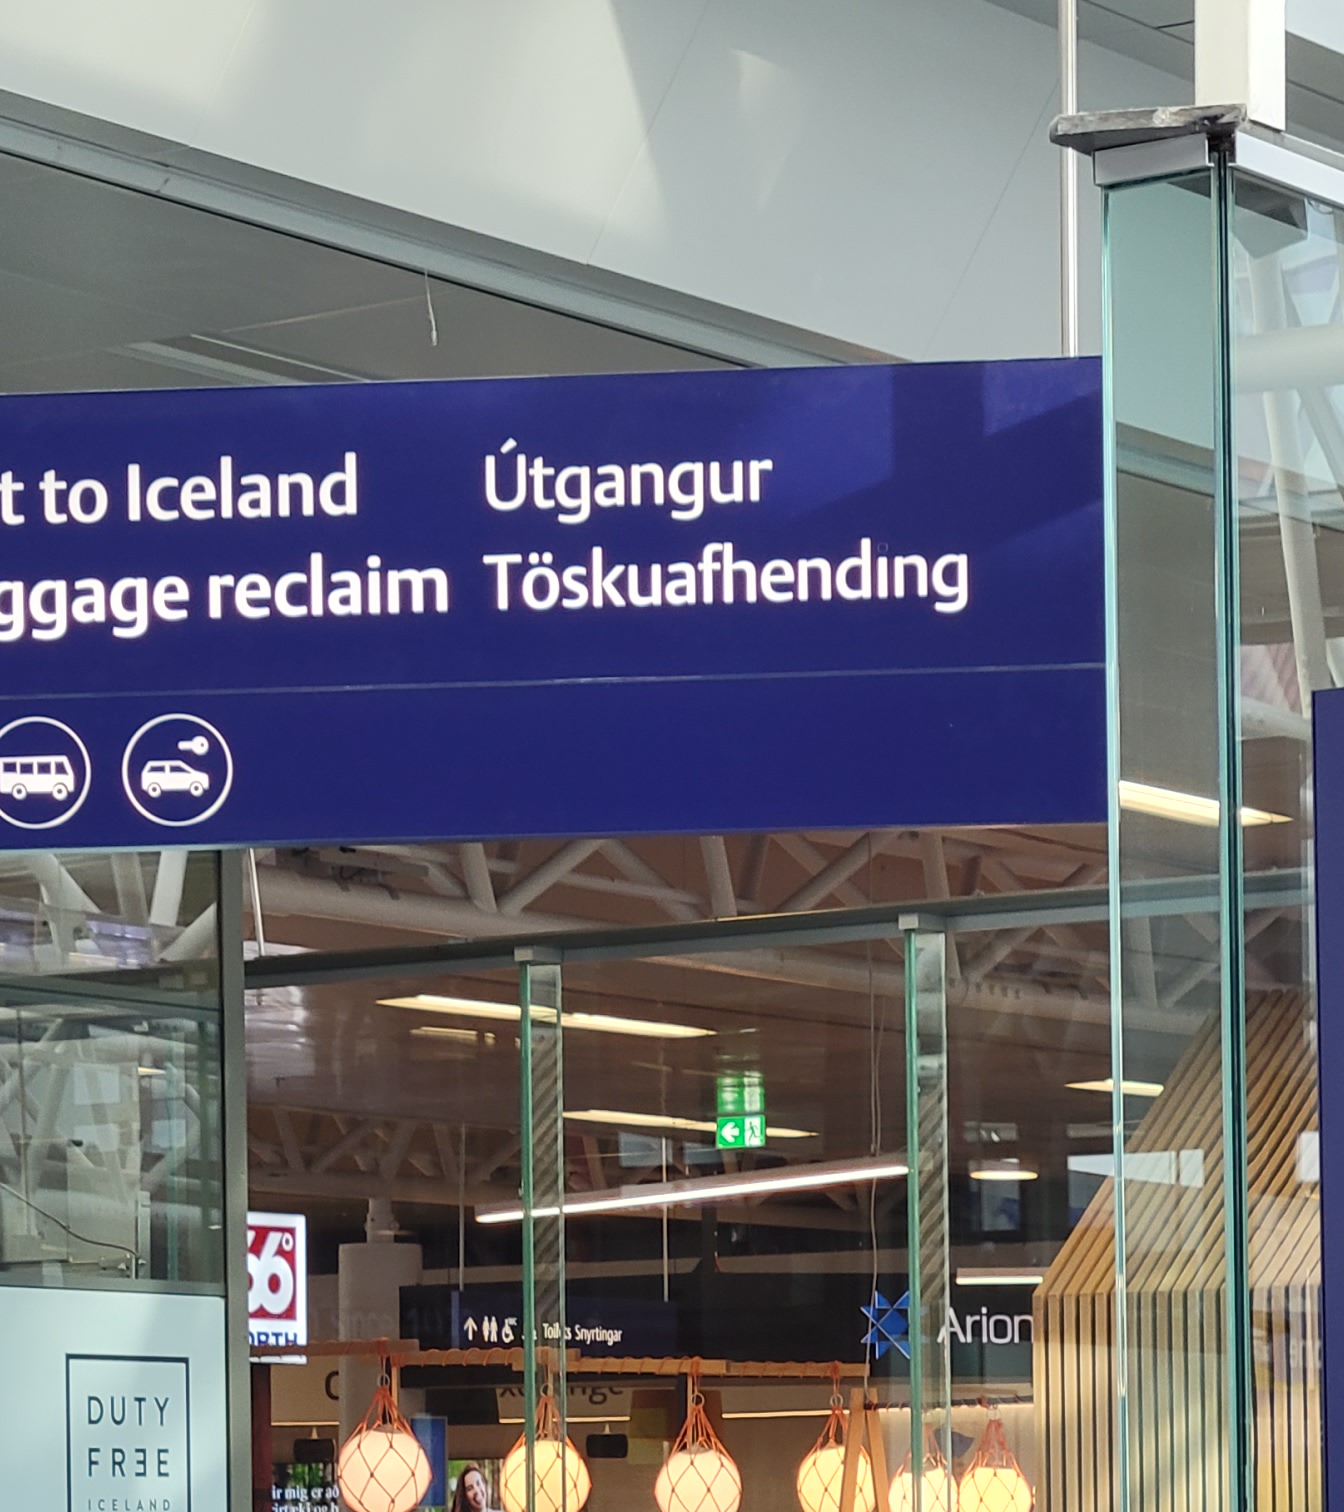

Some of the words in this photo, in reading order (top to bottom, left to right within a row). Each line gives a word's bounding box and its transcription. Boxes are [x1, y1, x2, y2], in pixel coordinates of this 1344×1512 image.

[39, 469, 108, 525] to
[127, 451, 358, 522] Iceland
[484, 437, 774, 525] Útgangur
[209, 551, 449, 619] reclaim
[482, 537, 969, 614] Töskuafhending
[575, 1324, 623, 1346] Snyrtingar
[937, 1306, 1033, 1344] Arion
[87, 1396, 170, 1426] DUTY
[88, 1499, 171, 1512] ICELAND
